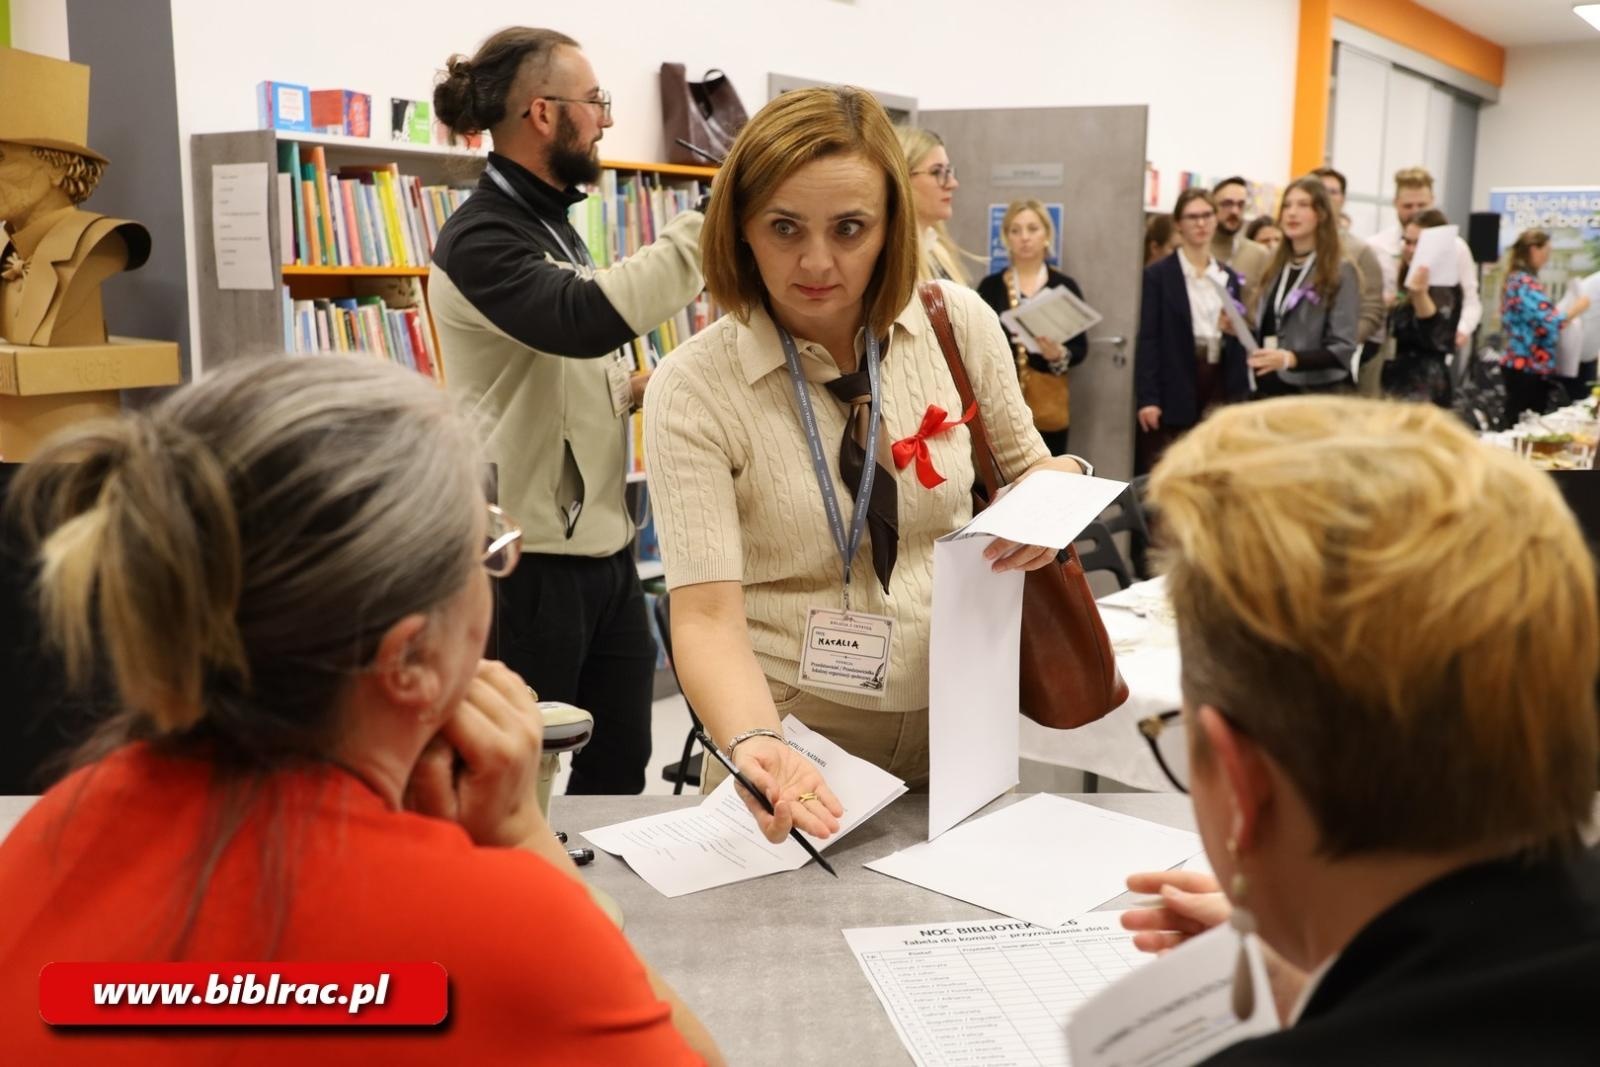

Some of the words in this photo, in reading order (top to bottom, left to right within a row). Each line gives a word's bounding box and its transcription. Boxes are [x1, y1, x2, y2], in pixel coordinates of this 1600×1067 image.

[818, 637, 859, 649] NATALIA
[919, 928, 954, 937] NOC
[956, 921, 1034, 935] BIBLIOTEK
[902, 938, 938, 947] Tabela
[940, 936, 957, 944] dla
[958, 933, 997, 943] komisji
